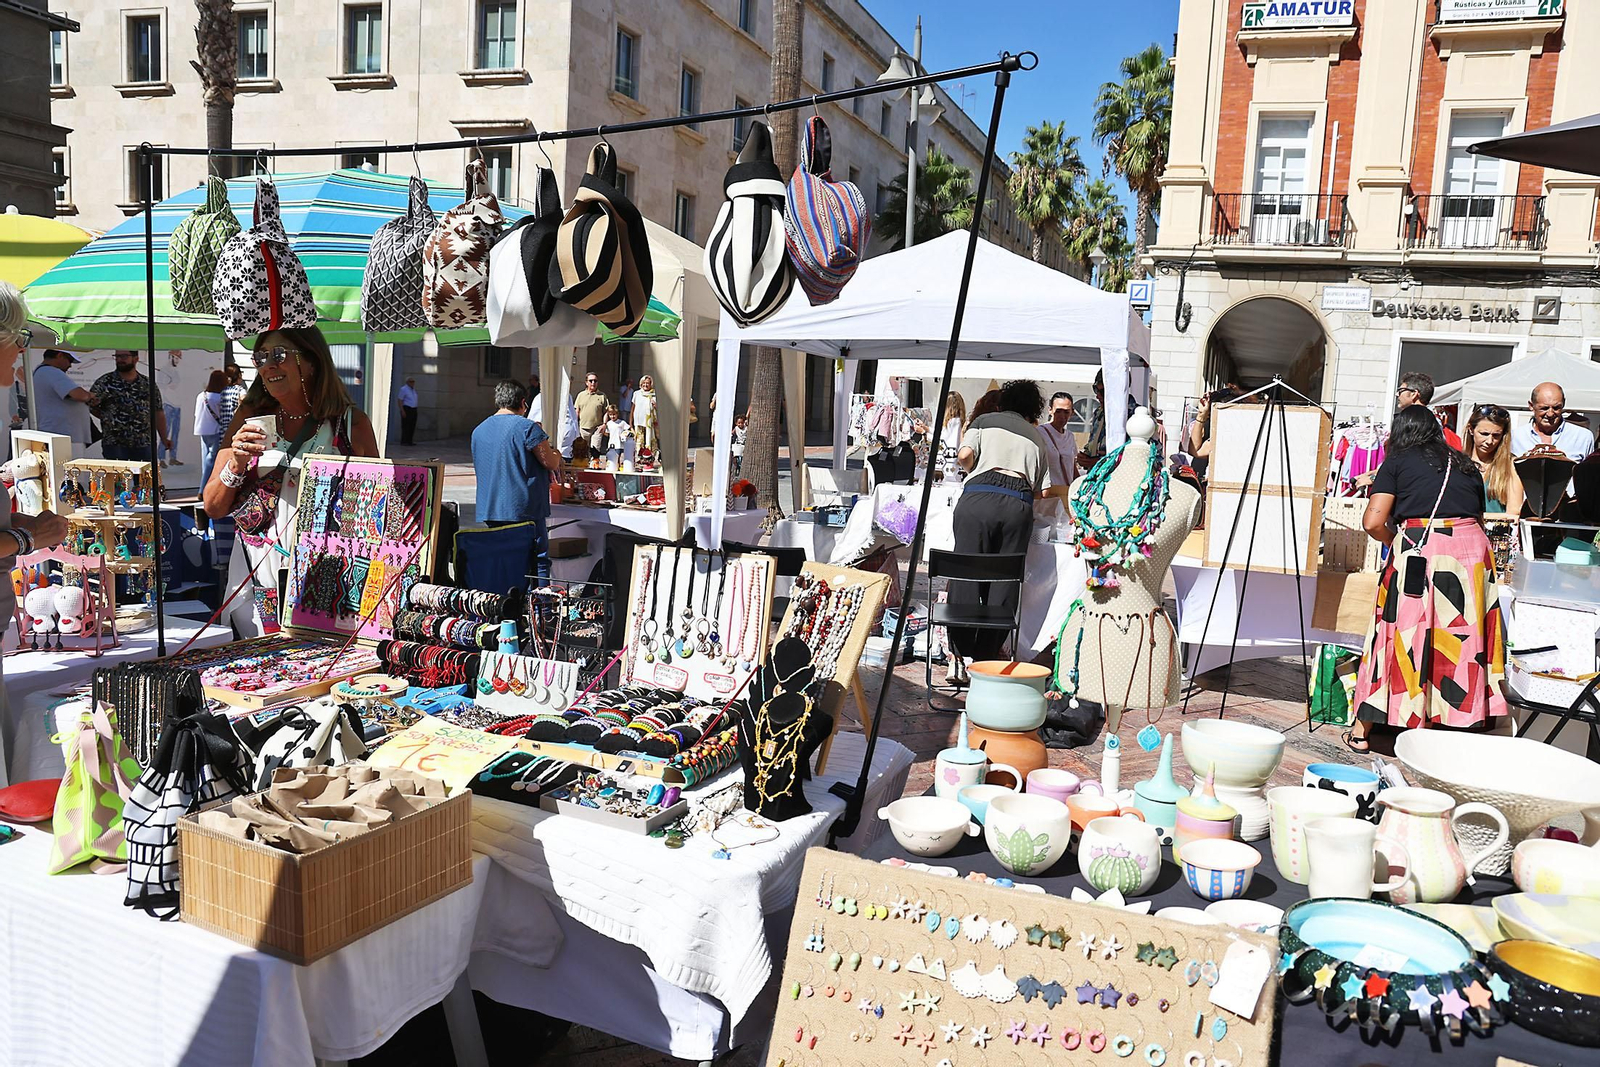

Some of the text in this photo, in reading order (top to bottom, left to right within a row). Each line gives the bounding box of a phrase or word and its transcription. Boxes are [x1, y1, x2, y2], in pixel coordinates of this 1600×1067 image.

[1266, 2, 1352, 17] AMATUR
[1372, 299, 1520, 323] Deutsche Bank
[435, 726, 498, 745] SOBRES
